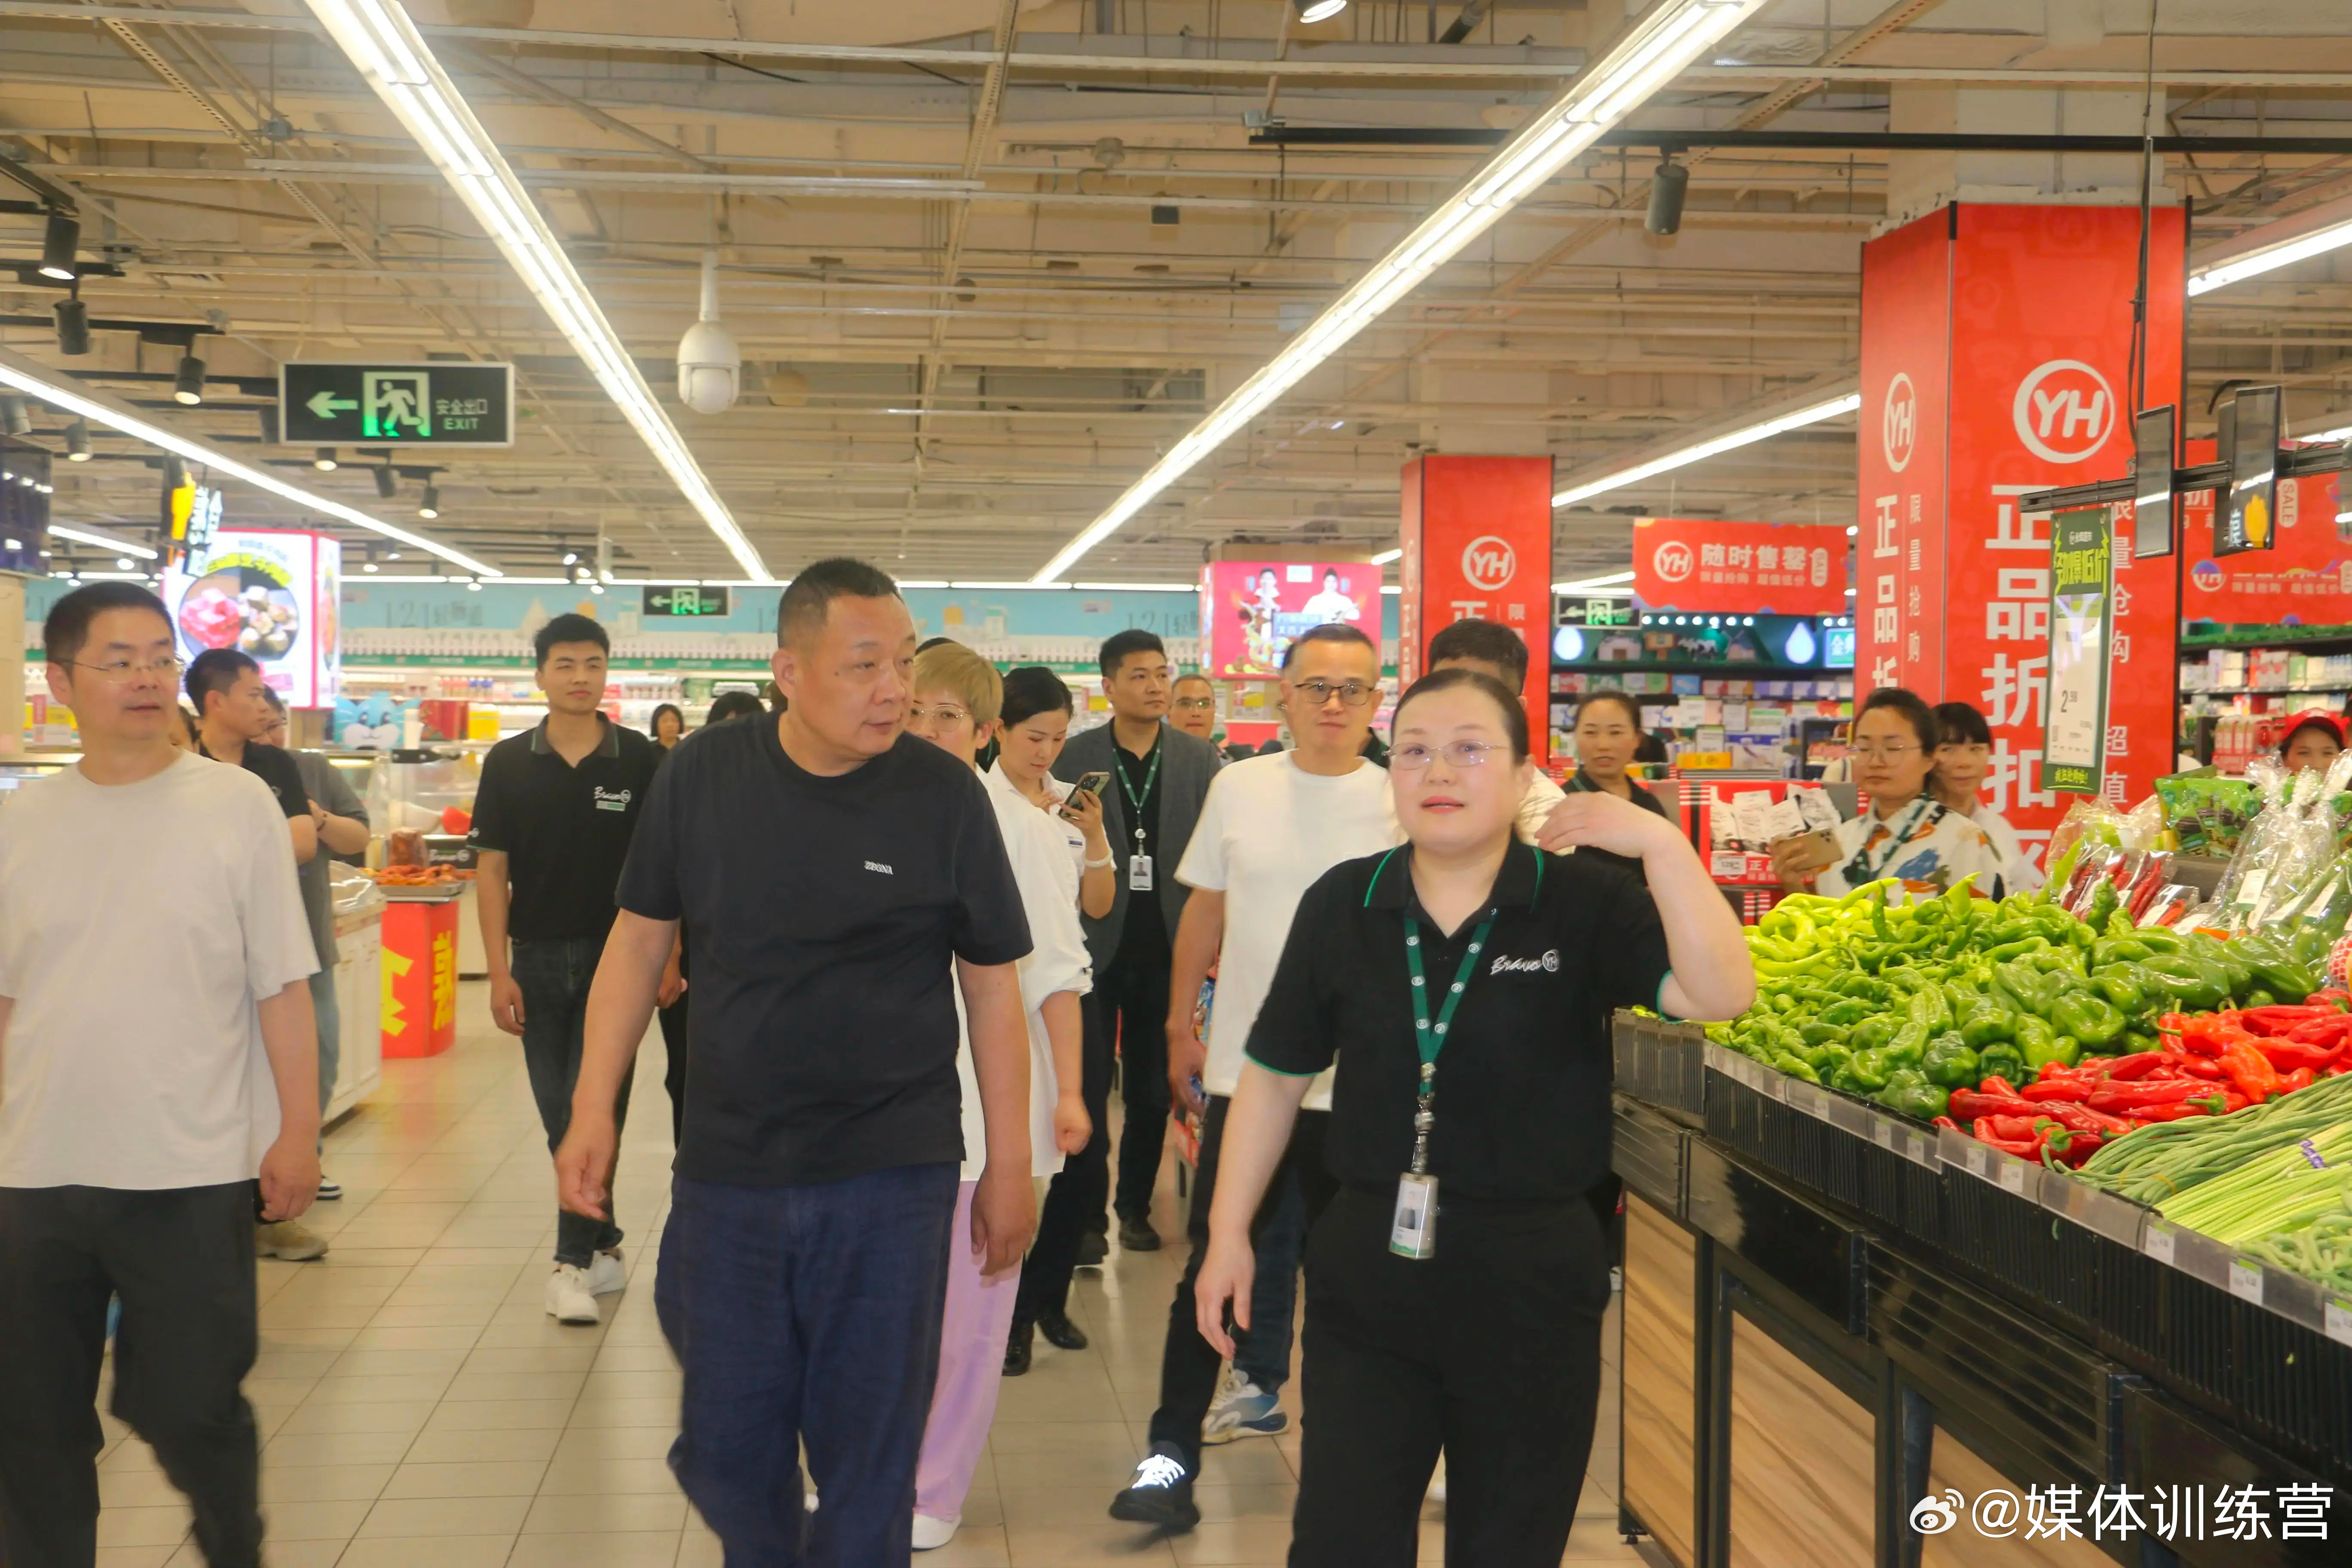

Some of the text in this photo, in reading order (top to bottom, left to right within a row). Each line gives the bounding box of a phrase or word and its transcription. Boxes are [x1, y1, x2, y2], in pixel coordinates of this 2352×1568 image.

[435, 398, 488, 415] 安全出口
[444, 418, 478, 429] EXIT
[2281, 483, 2296, 523] SALE
[1700, 543, 1807, 570] 随时售罄
[2053, 549, 2110, 585] 劲爆低价
[864, 861, 894, 875] ZEGNA
[1490, 955, 1542, 975] Bravo
